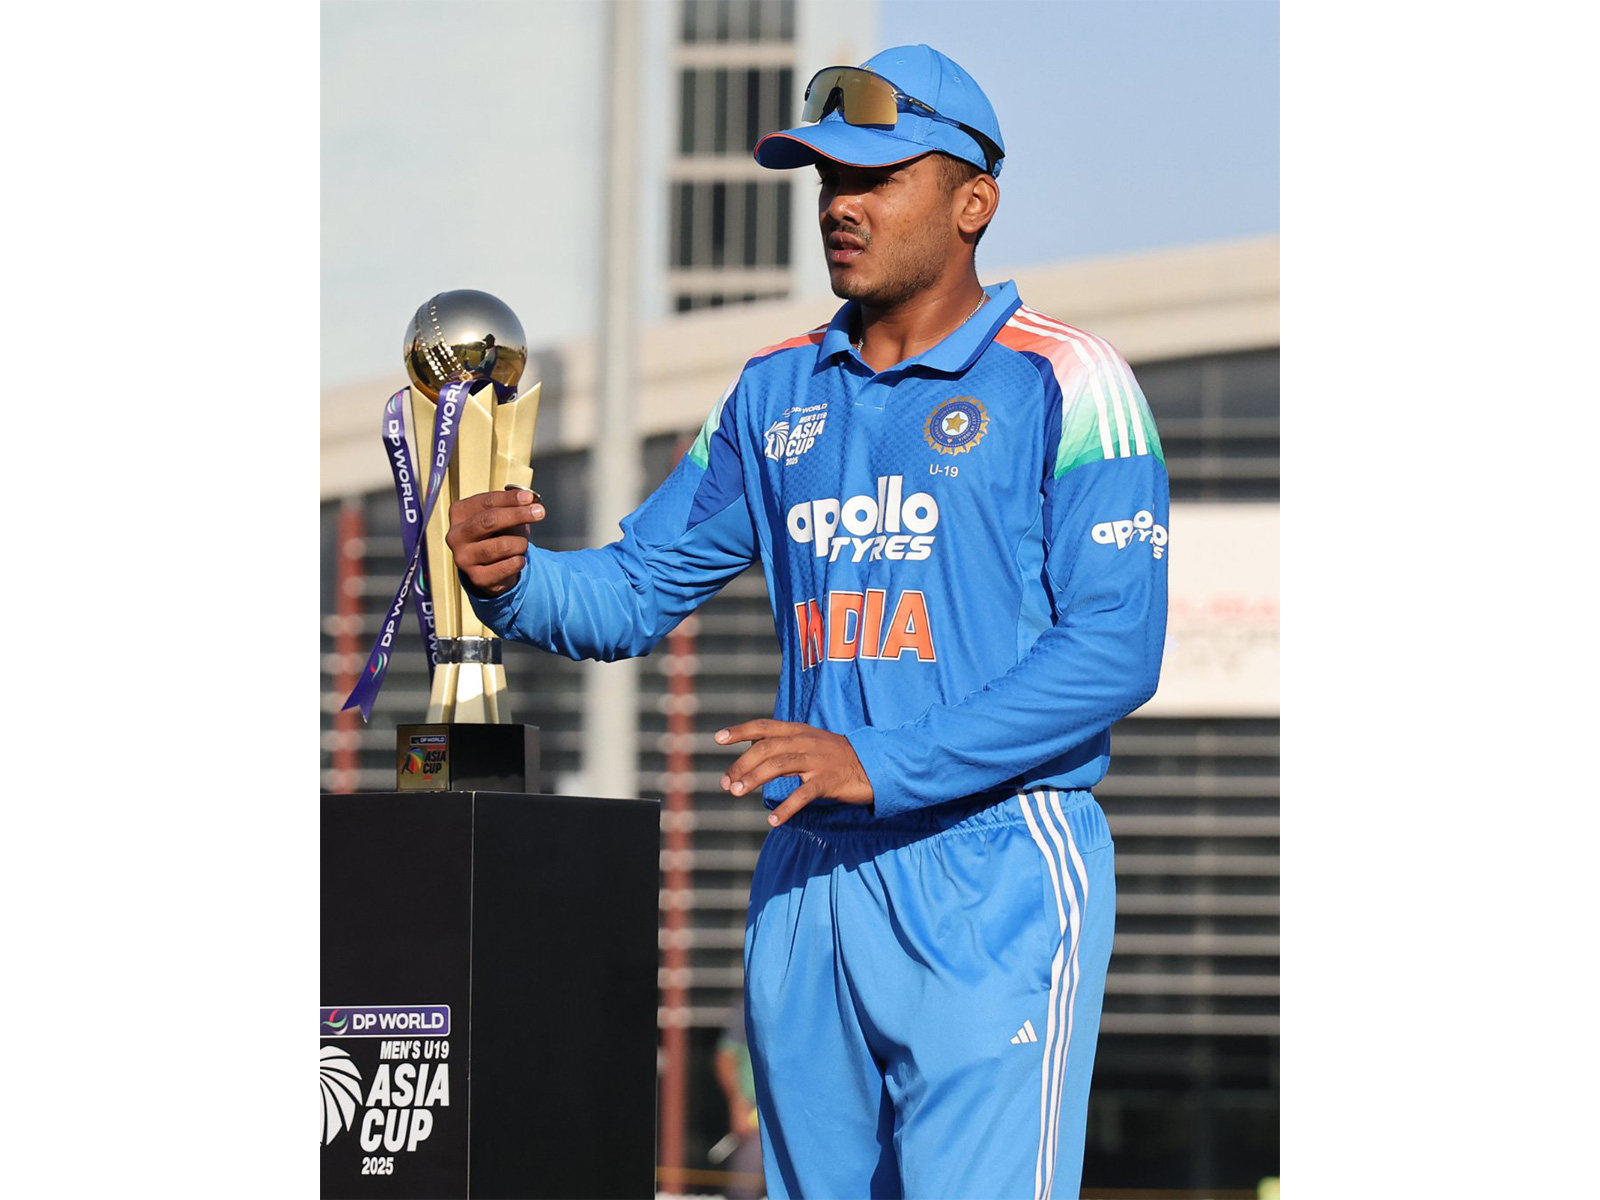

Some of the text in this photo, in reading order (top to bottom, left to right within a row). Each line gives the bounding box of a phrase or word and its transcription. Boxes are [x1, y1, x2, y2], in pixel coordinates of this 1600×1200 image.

[436, 380, 467, 468] DP WORL
[789, 420, 825, 440] ASIA
[785, 437, 815, 457] CUP
[388, 419, 417, 523] DP WORLD
[929, 463, 959, 478] U-19
[787, 475, 939, 558] apollo
[1091, 508, 1168, 550] apoo
[829, 535, 936, 563] TYRES
[380, 545, 420, 648] DP WORL
[423, 762, 442, 774] CUP
[424, 750, 446, 762] ASIA
[352, 1012, 445, 1030] DP WORLD
[379, 1040, 450, 1060] MEN'S U19
[365, 1063, 450, 1107] ASIA
[360, 1108, 434, 1153] CUP
[361, 1156, 395, 1175] 2025
